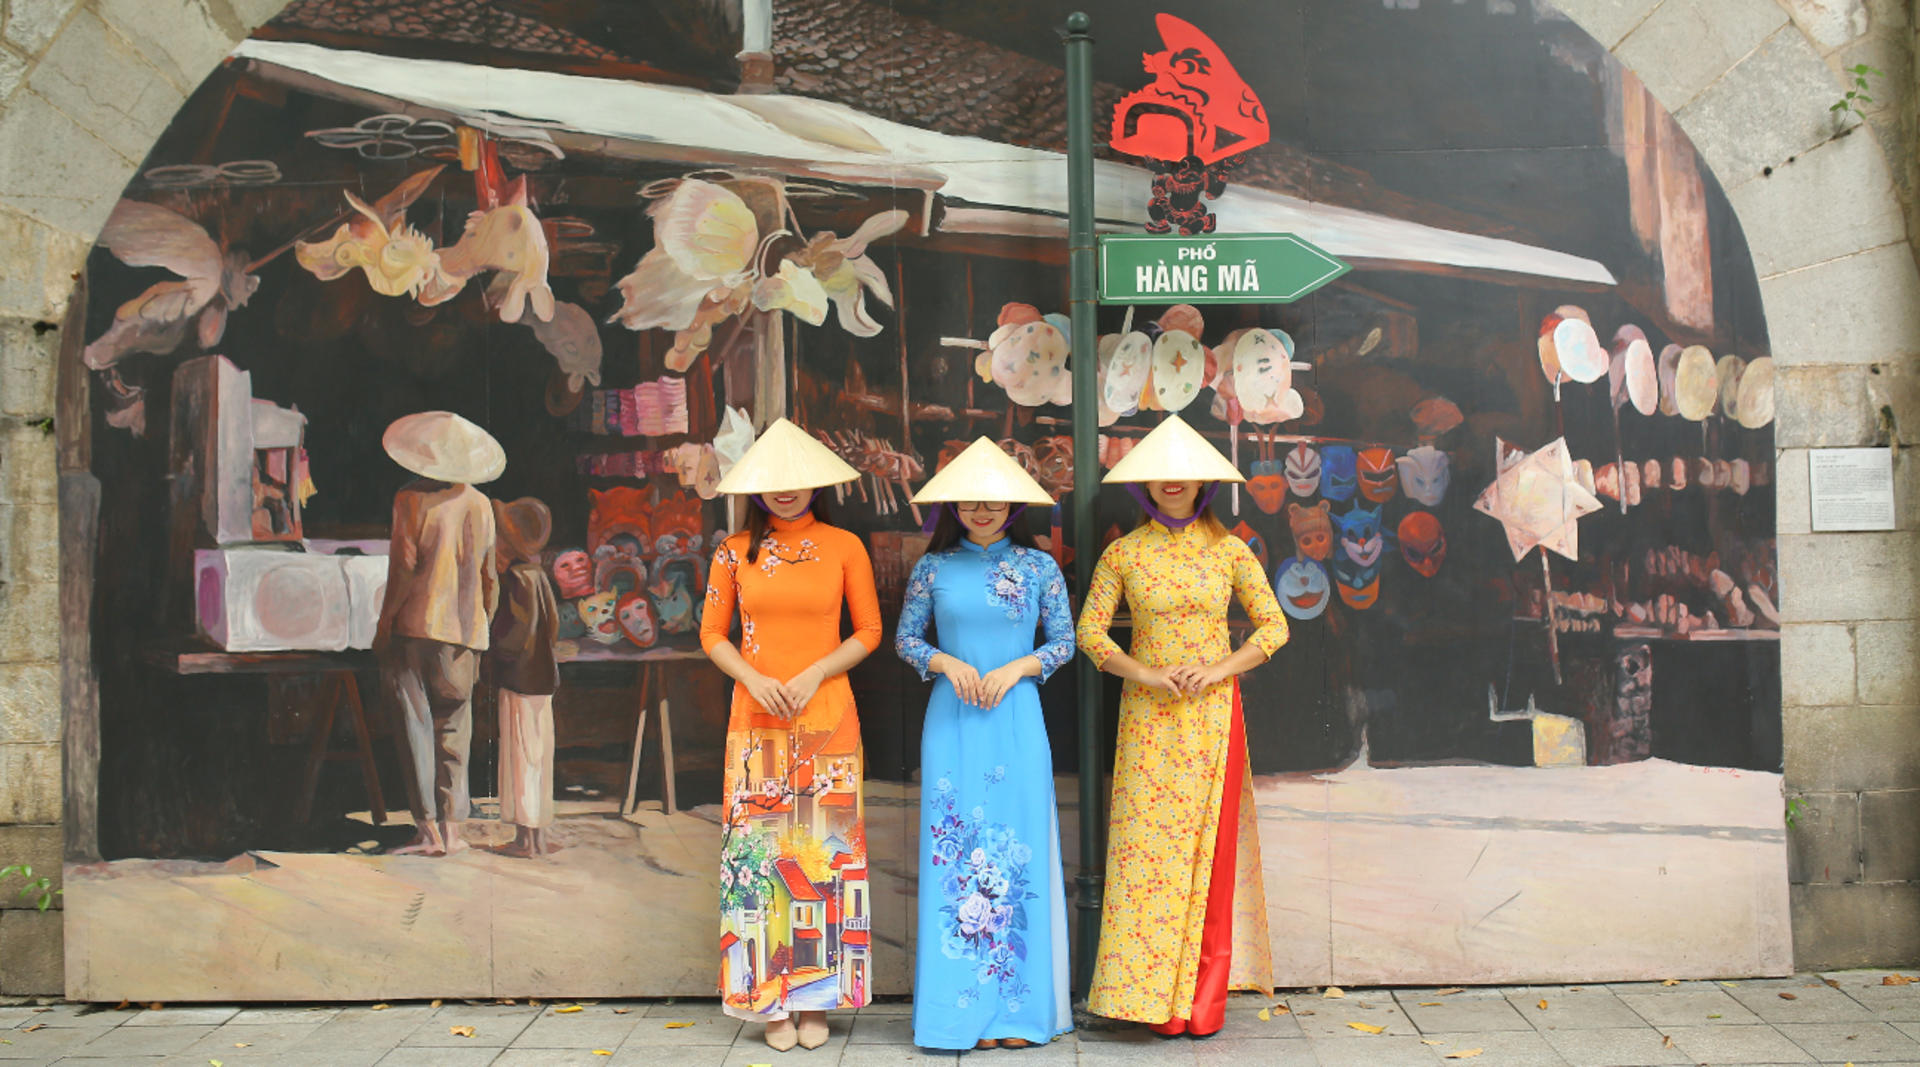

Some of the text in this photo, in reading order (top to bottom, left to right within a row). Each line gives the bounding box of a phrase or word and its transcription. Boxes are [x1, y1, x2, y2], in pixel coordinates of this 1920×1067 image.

[1178, 242, 1217, 260] PHỐ
[1136, 259, 1260, 292] HÀNG MÃ
